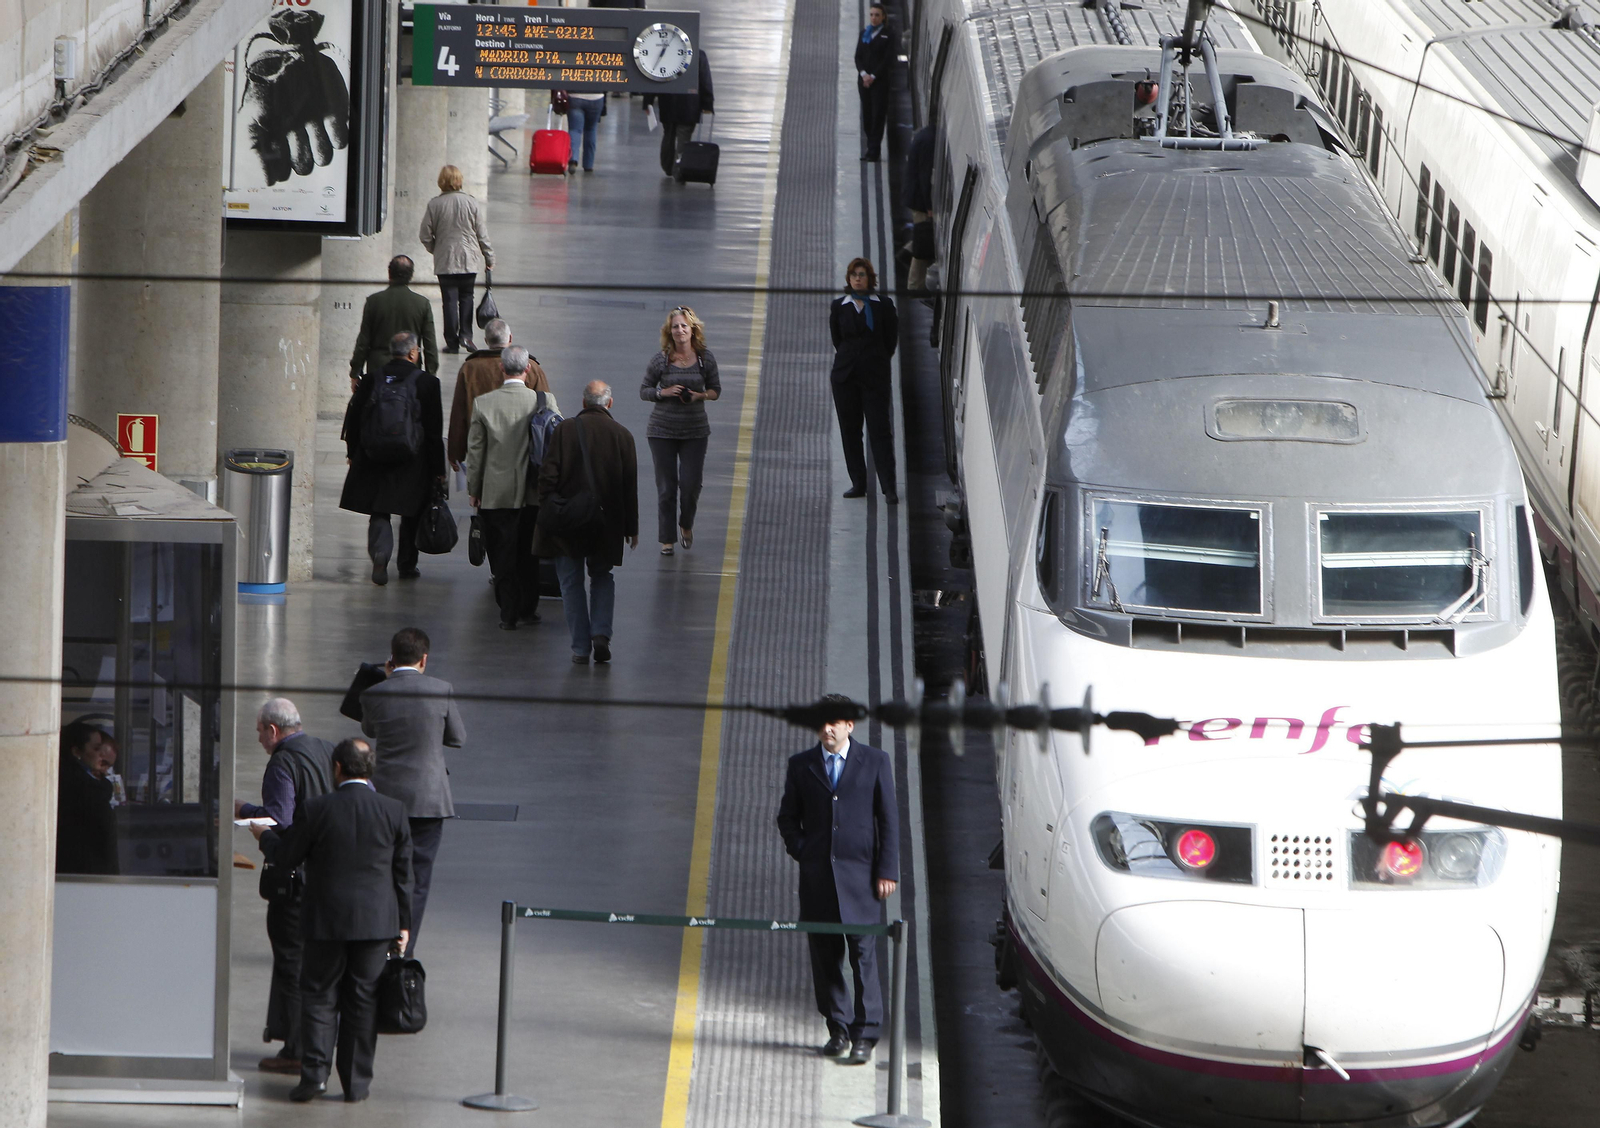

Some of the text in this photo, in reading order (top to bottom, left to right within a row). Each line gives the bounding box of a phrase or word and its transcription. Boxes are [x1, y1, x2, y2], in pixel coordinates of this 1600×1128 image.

[475, 13, 495, 22] Hora
[523, 15, 542, 24] Tren
[476, 23, 595, 40] 12:45 AVE-02121
[658, 31, 668, 39] 12
[475, 39, 506, 48] Destino
[641, 49, 649, 57] 9
[677, 49, 684, 57] 3
[437, 46, 460, 77] 4
[479, 49, 624, 67] MADRID PTA. ATOCHA
[659, 66, 667, 74] 6
